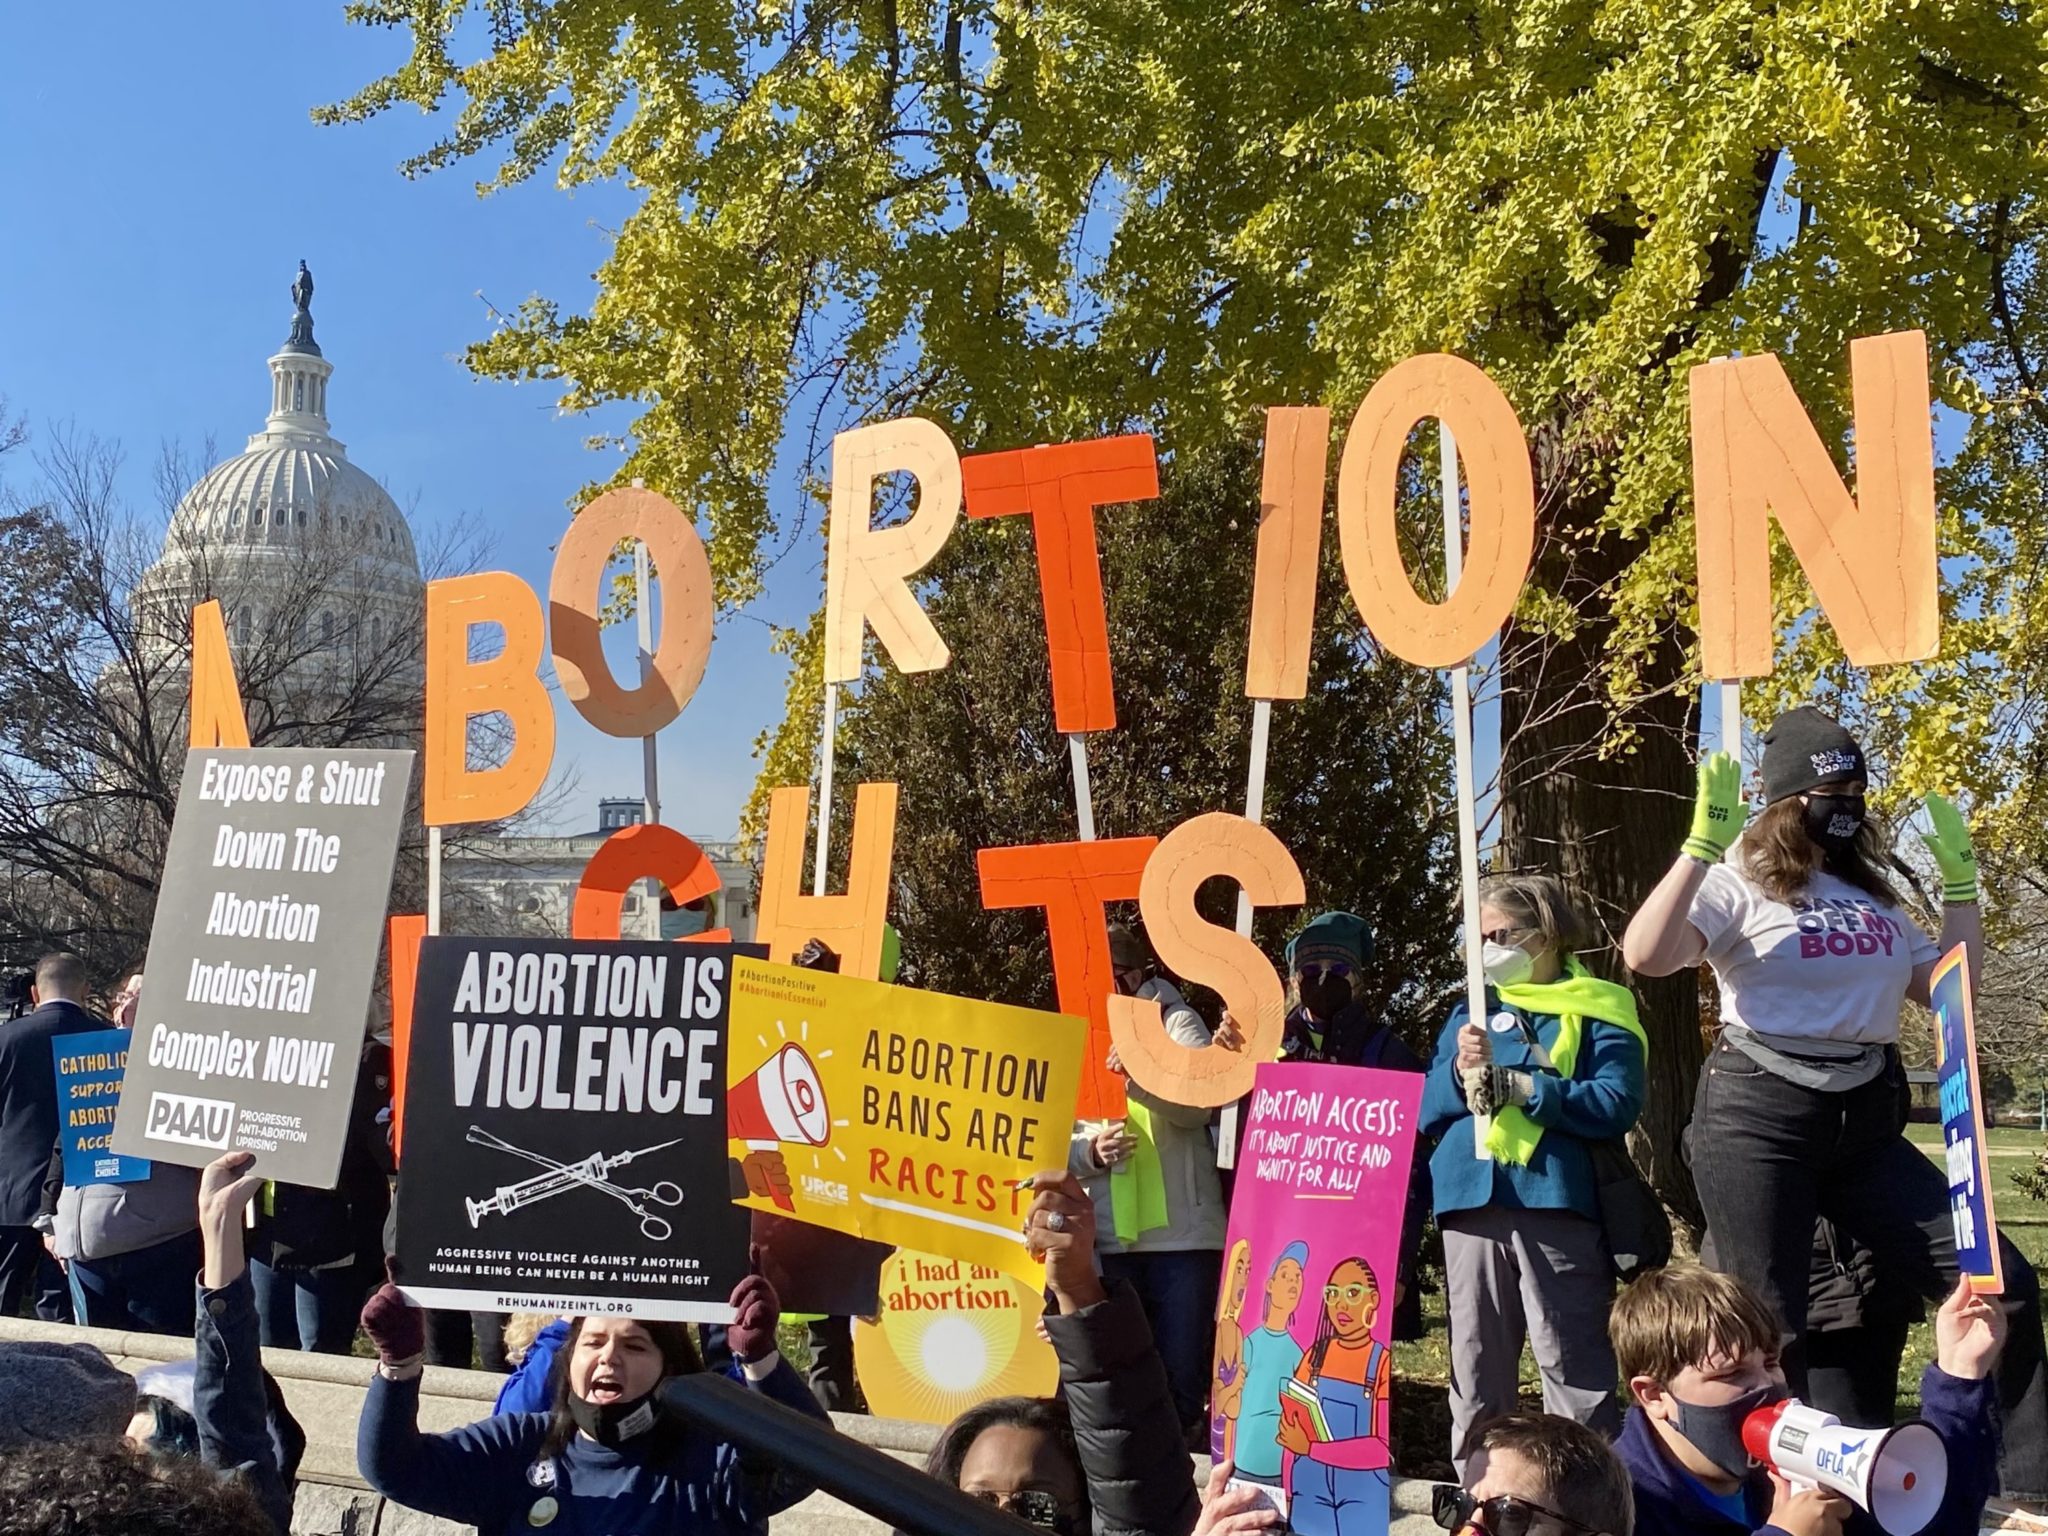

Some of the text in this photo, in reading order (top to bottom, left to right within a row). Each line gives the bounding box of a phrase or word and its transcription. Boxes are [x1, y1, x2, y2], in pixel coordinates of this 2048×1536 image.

[1810, 748, 1841, 762] BANS
[1836, 754, 1857, 763] OUR
[199, 758, 386, 807] Expose & Shut
[1708, 811, 1728, 822] OFF
[212, 824, 341, 873] Down The
[205, 892, 321, 942] Abortion
[1797, 912, 1903, 938] OFF MY
[1800, 932, 1893, 959] BODY
[186, 958, 317, 1014] Industrial
[452, 951, 725, 1020] ABORTION IS
[740, 968, 817, 993] #AbortionPositive
[148, 1022, 335, 1088] Complex NOW!
[452, 1022, 718, 1115] VIOLENCE
[861, 1029, 1050, 1104] ABORTION
[70, 1081, 123, 1099] SUPPOR
[150, 1098, 230, 1143] PAAU
[240, 1109, 302, 1129] PROGRESSIVE
[862, 1084, 1040, 1162] BANS ARE
[1251, 1088, 1405, 1137] ABORTION ACCESS:
[77, 1136, 112, 1152] ACCE
[236, 1135, 278, 1152] UPRISING
[237, 1122, 307, 1143] ANTI-ABORTION
[1266, 1131, 1302, 1157] ABOUT
[1300, 1135, 1358, 1165] JUSTICE
[1360, 1143, 1392, 1169] AND
[800, 1174, 848, 1201] URGE
[868, 1148, 1024, 1217] RACIST
[1256, 1158, 1363, 1194] DIGNITY FOR ALL!
[436, 1247, 700, 1270] AGGRESSIVE VIOLENCE AGAINST ANOTHER
[900, 1260, 907, 1282] i
[916, 1259, 960, 1281] had
[429, 1262, 711, 1286] HUMAN BEING CAN NEVER BE A HUMAN RIGHT
[497, 1297, 633, 1313] REHUMANIZEINTL.ORG
[888, 1283, 1018, 1311] abortion.
